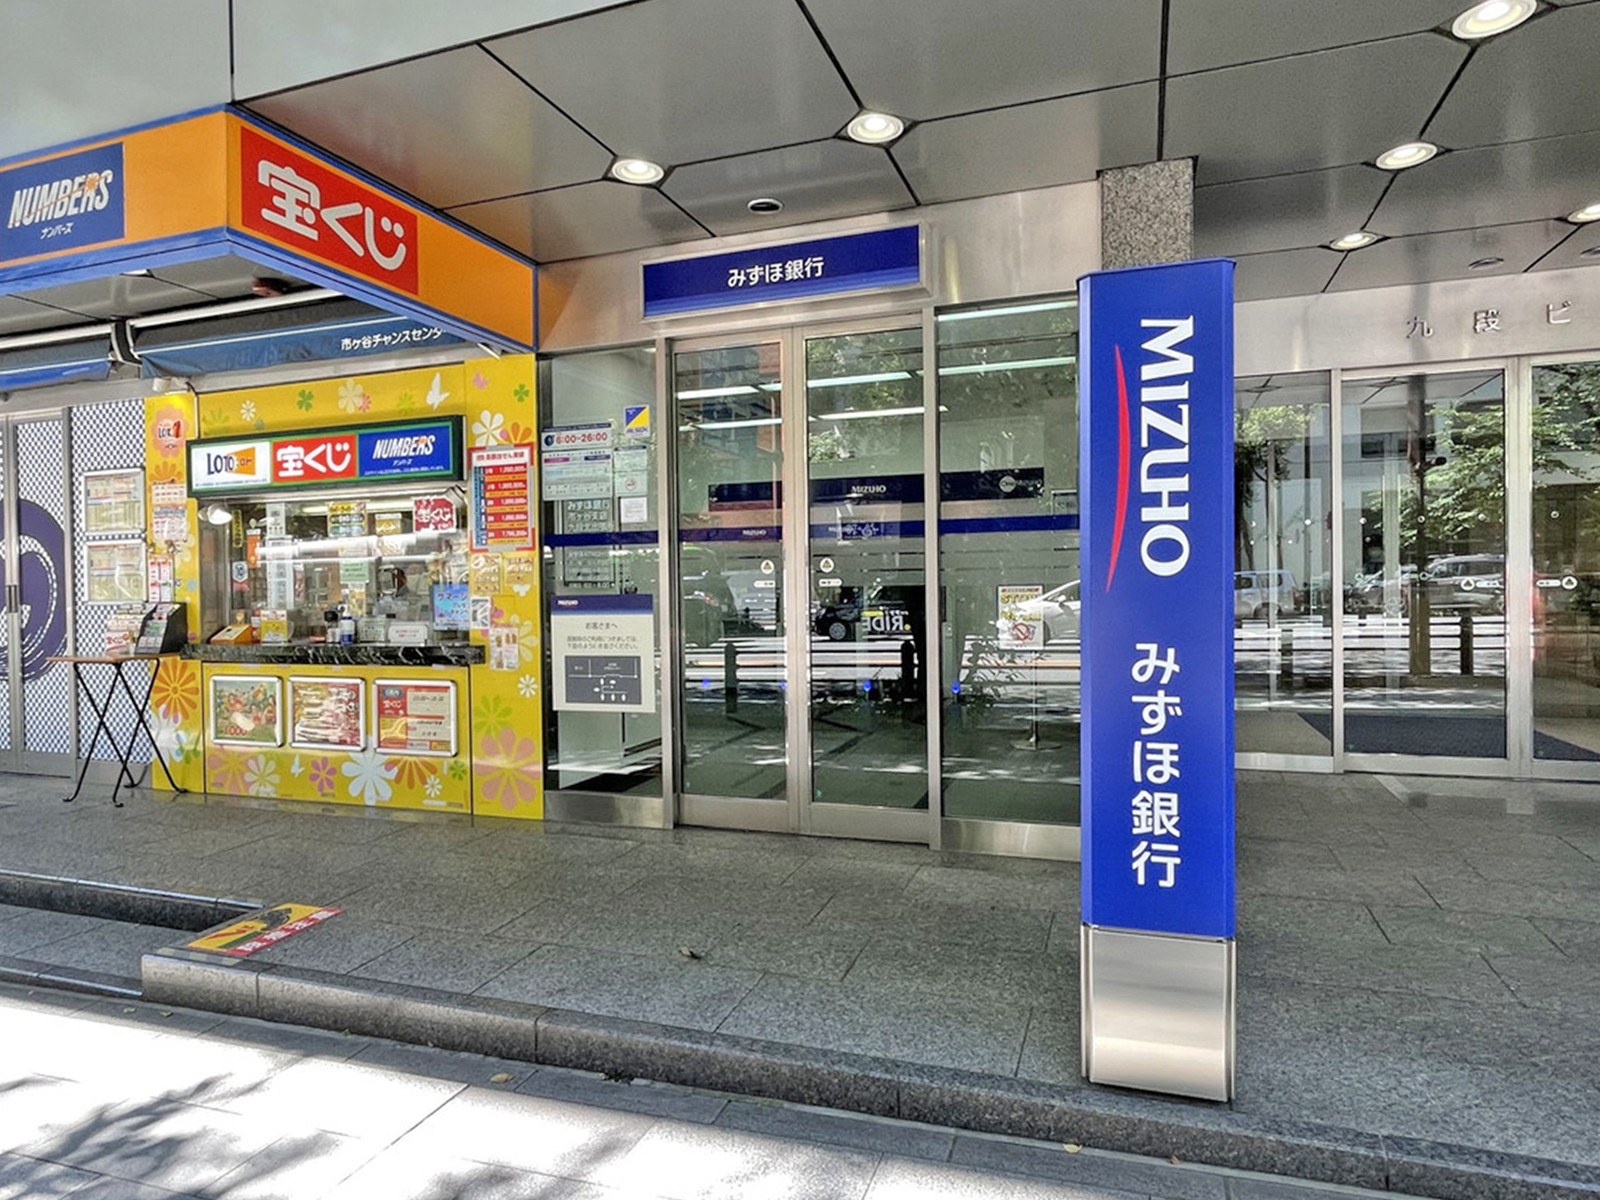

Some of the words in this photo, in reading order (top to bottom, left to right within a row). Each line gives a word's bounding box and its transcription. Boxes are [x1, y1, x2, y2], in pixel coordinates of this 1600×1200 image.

[8, 169, 113, 229] NUMBERS
[258, 159, 407, 271] 宝くじ
[40, 222, 74, 240] ナンバーズ
[727, 256, 824, 288] みずほ銀行
[341, 327, 447, 351] 市ヶ谷チャンスセンタ
[277, 442, 352, 477] 宝くじ
[372, 434, 436, 459] NUMBERS
[1140, 315, 1194, 577] MIZUHO
[207, 452, 236, 475] LOTO
[851, 485, 887, 494] MIZUHO
[1131, 642, 1183, 888] みずほ銀行
